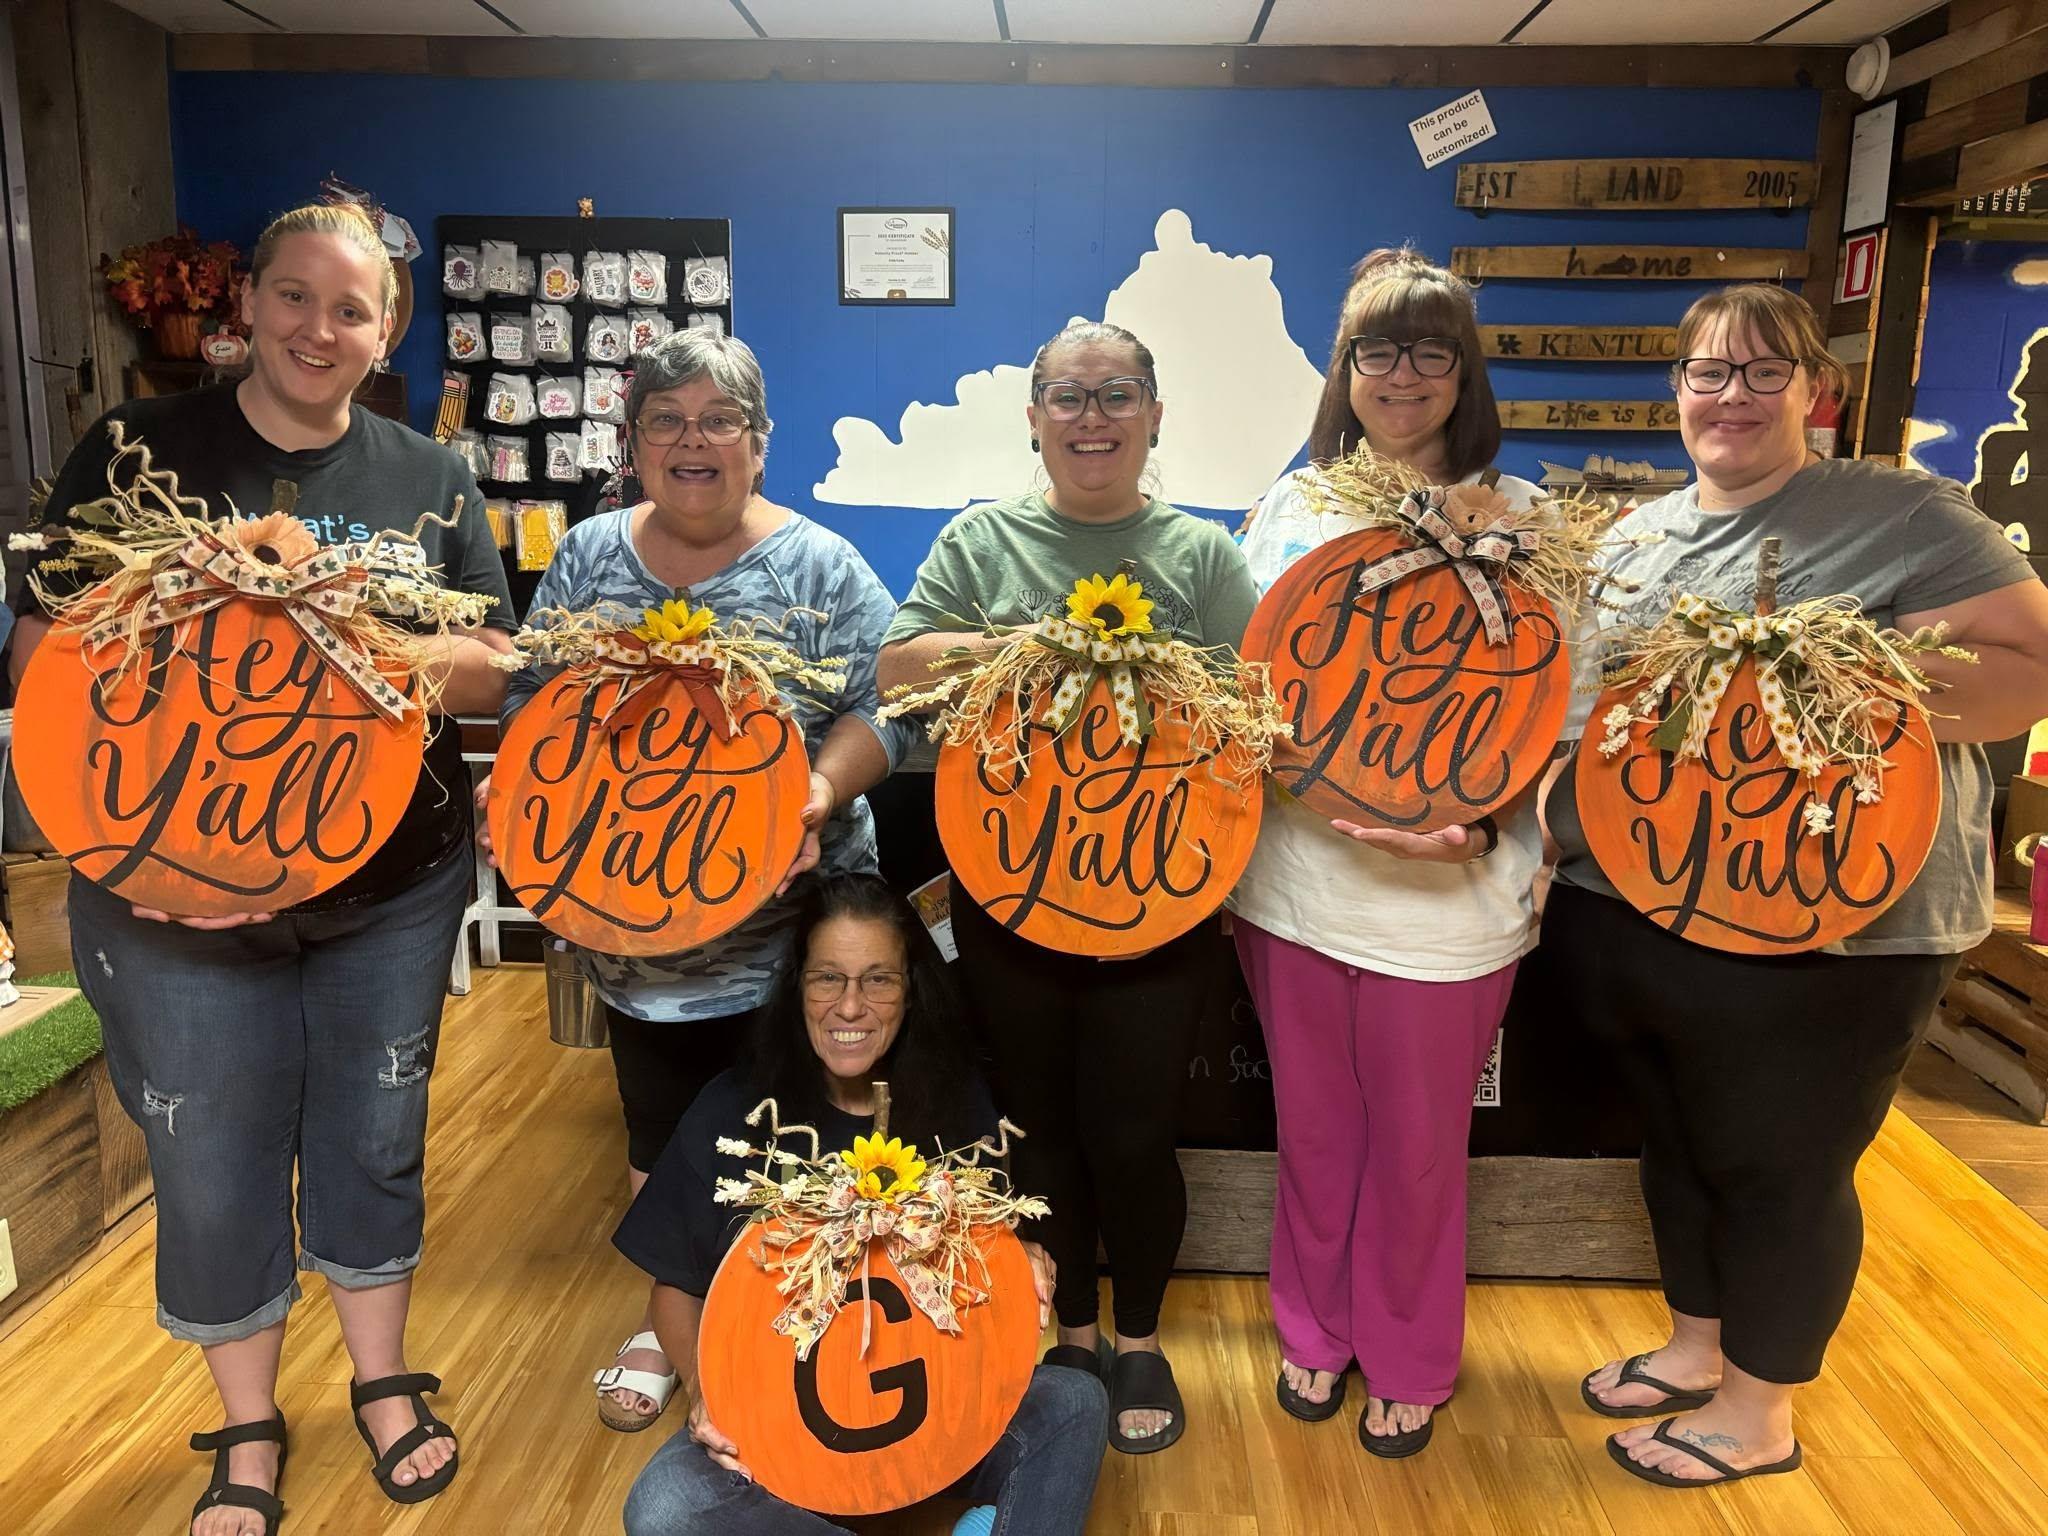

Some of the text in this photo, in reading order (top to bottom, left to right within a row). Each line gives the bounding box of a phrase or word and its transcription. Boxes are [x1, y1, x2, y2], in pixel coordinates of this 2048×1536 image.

[1413, 94, 1481, 133] This product
[1426, 124, 1491, 162] customized!
[1433, 119, 1469, 142] can be
[1474, 166, 1799, 201] EST LAND 2005
[1611, 404, 1636, 424] is
[90, 610, 415, 761] Hey
[1290, 557, 1560, 706] Hey
[67, 721, 373, 897] Y'all
[529, 675, 789, 812] Hey
[1272, 668, 1511, 826] Y'all
[511, 778, 747, 933] Y'all
[981, 777, 1213, 931] Y'all
[1631, 775, 1895, 944] Y'all
[793, 1276, 929, 1454] G
